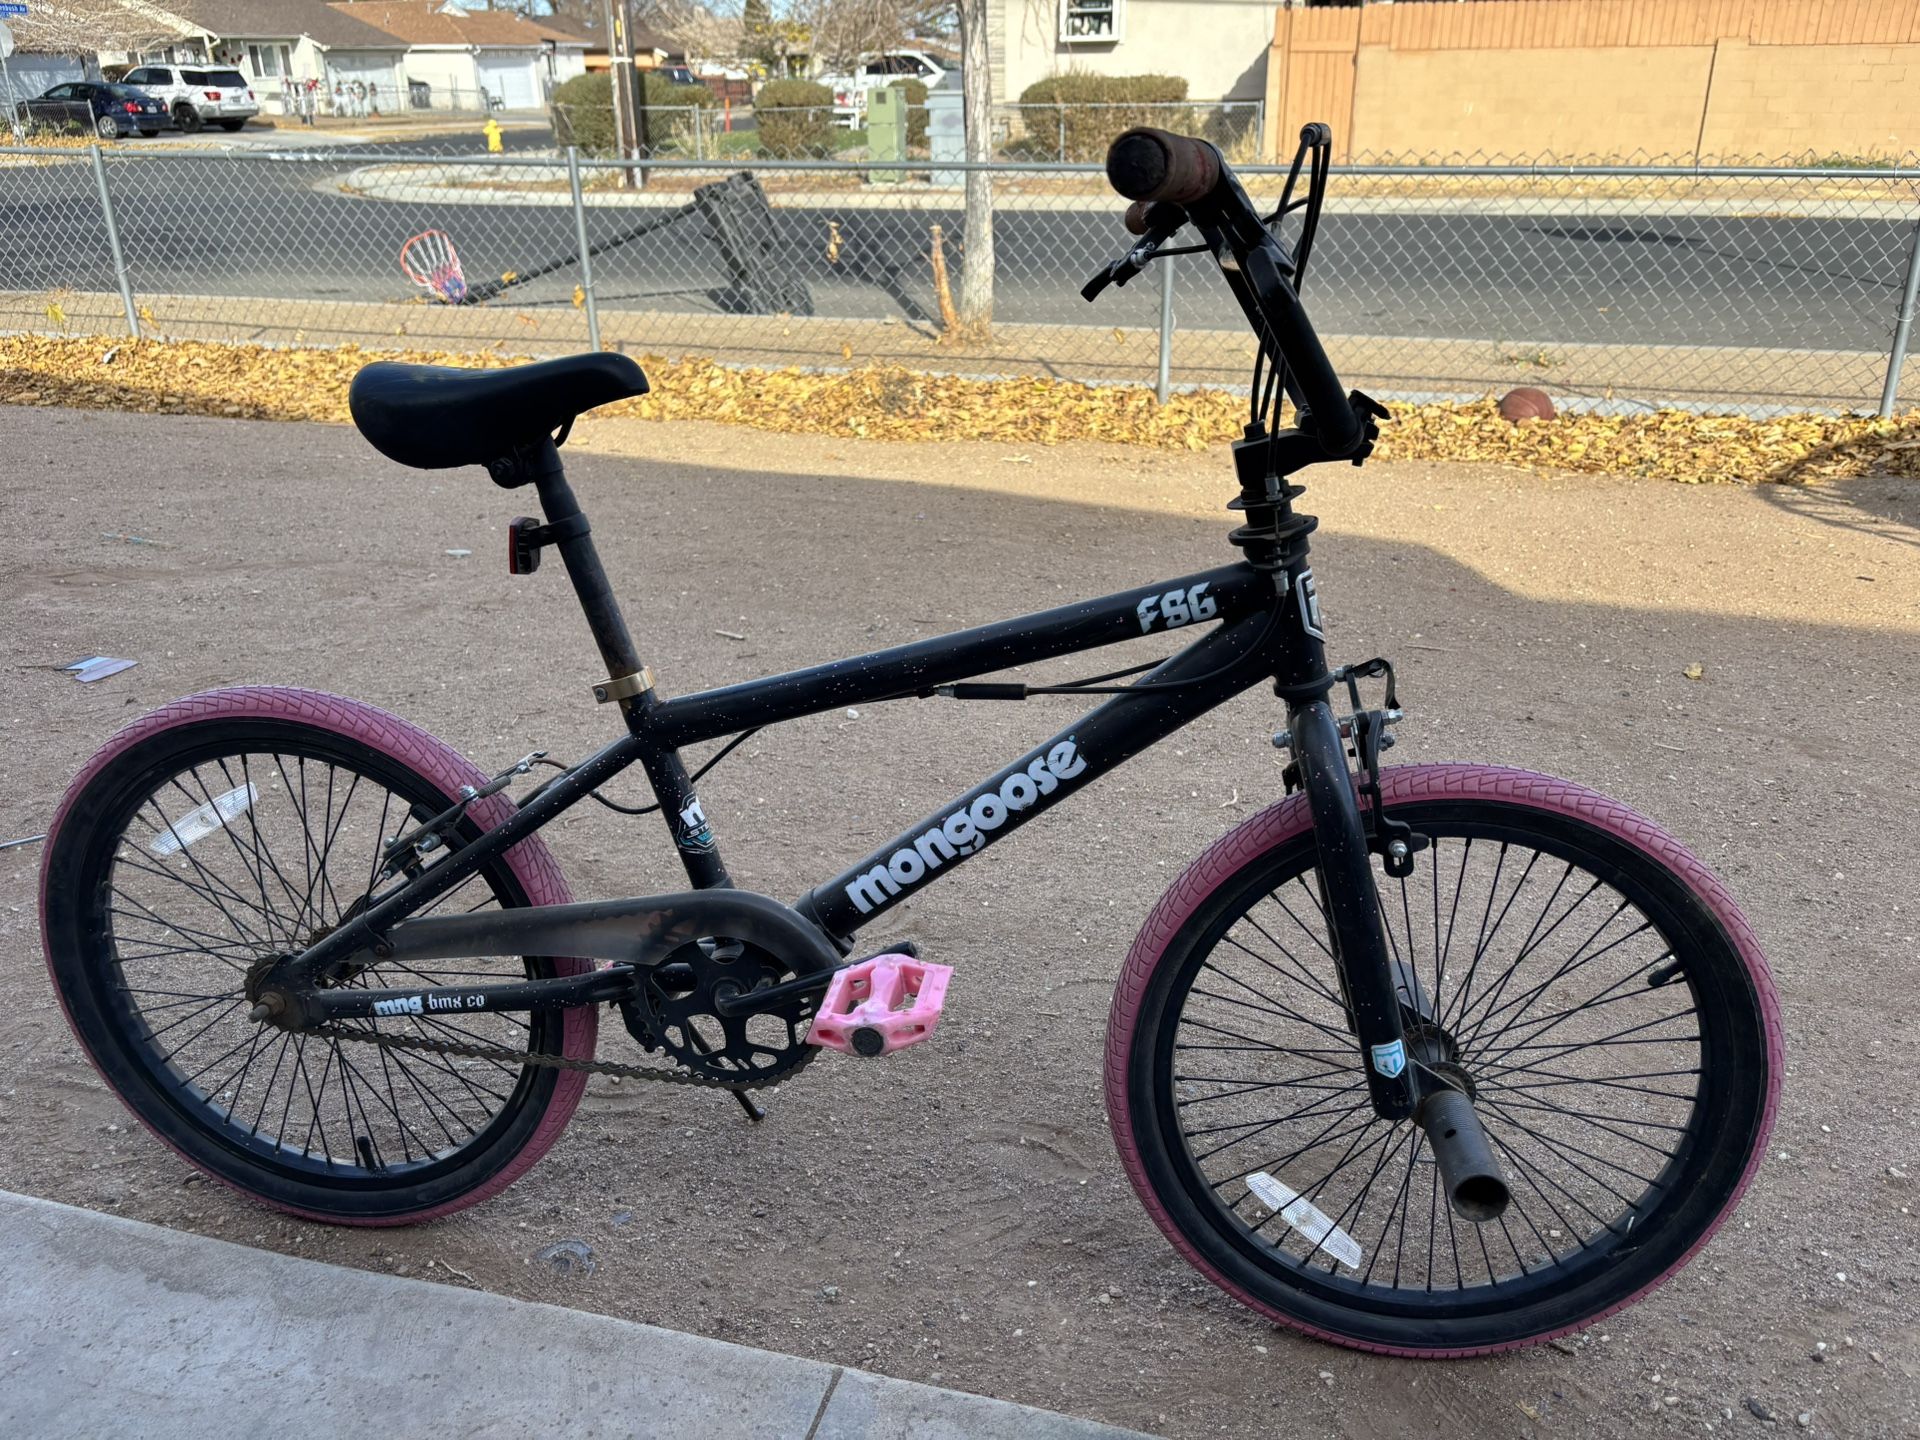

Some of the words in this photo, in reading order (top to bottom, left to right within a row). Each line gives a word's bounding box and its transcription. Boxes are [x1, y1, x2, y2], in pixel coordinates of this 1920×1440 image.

[845, 738, 1088, 914] mongoose
[374, 996, 424, 1016] mng
[428, 993, 462, 1010] bmx
[466, 994, 486, 1008] co
